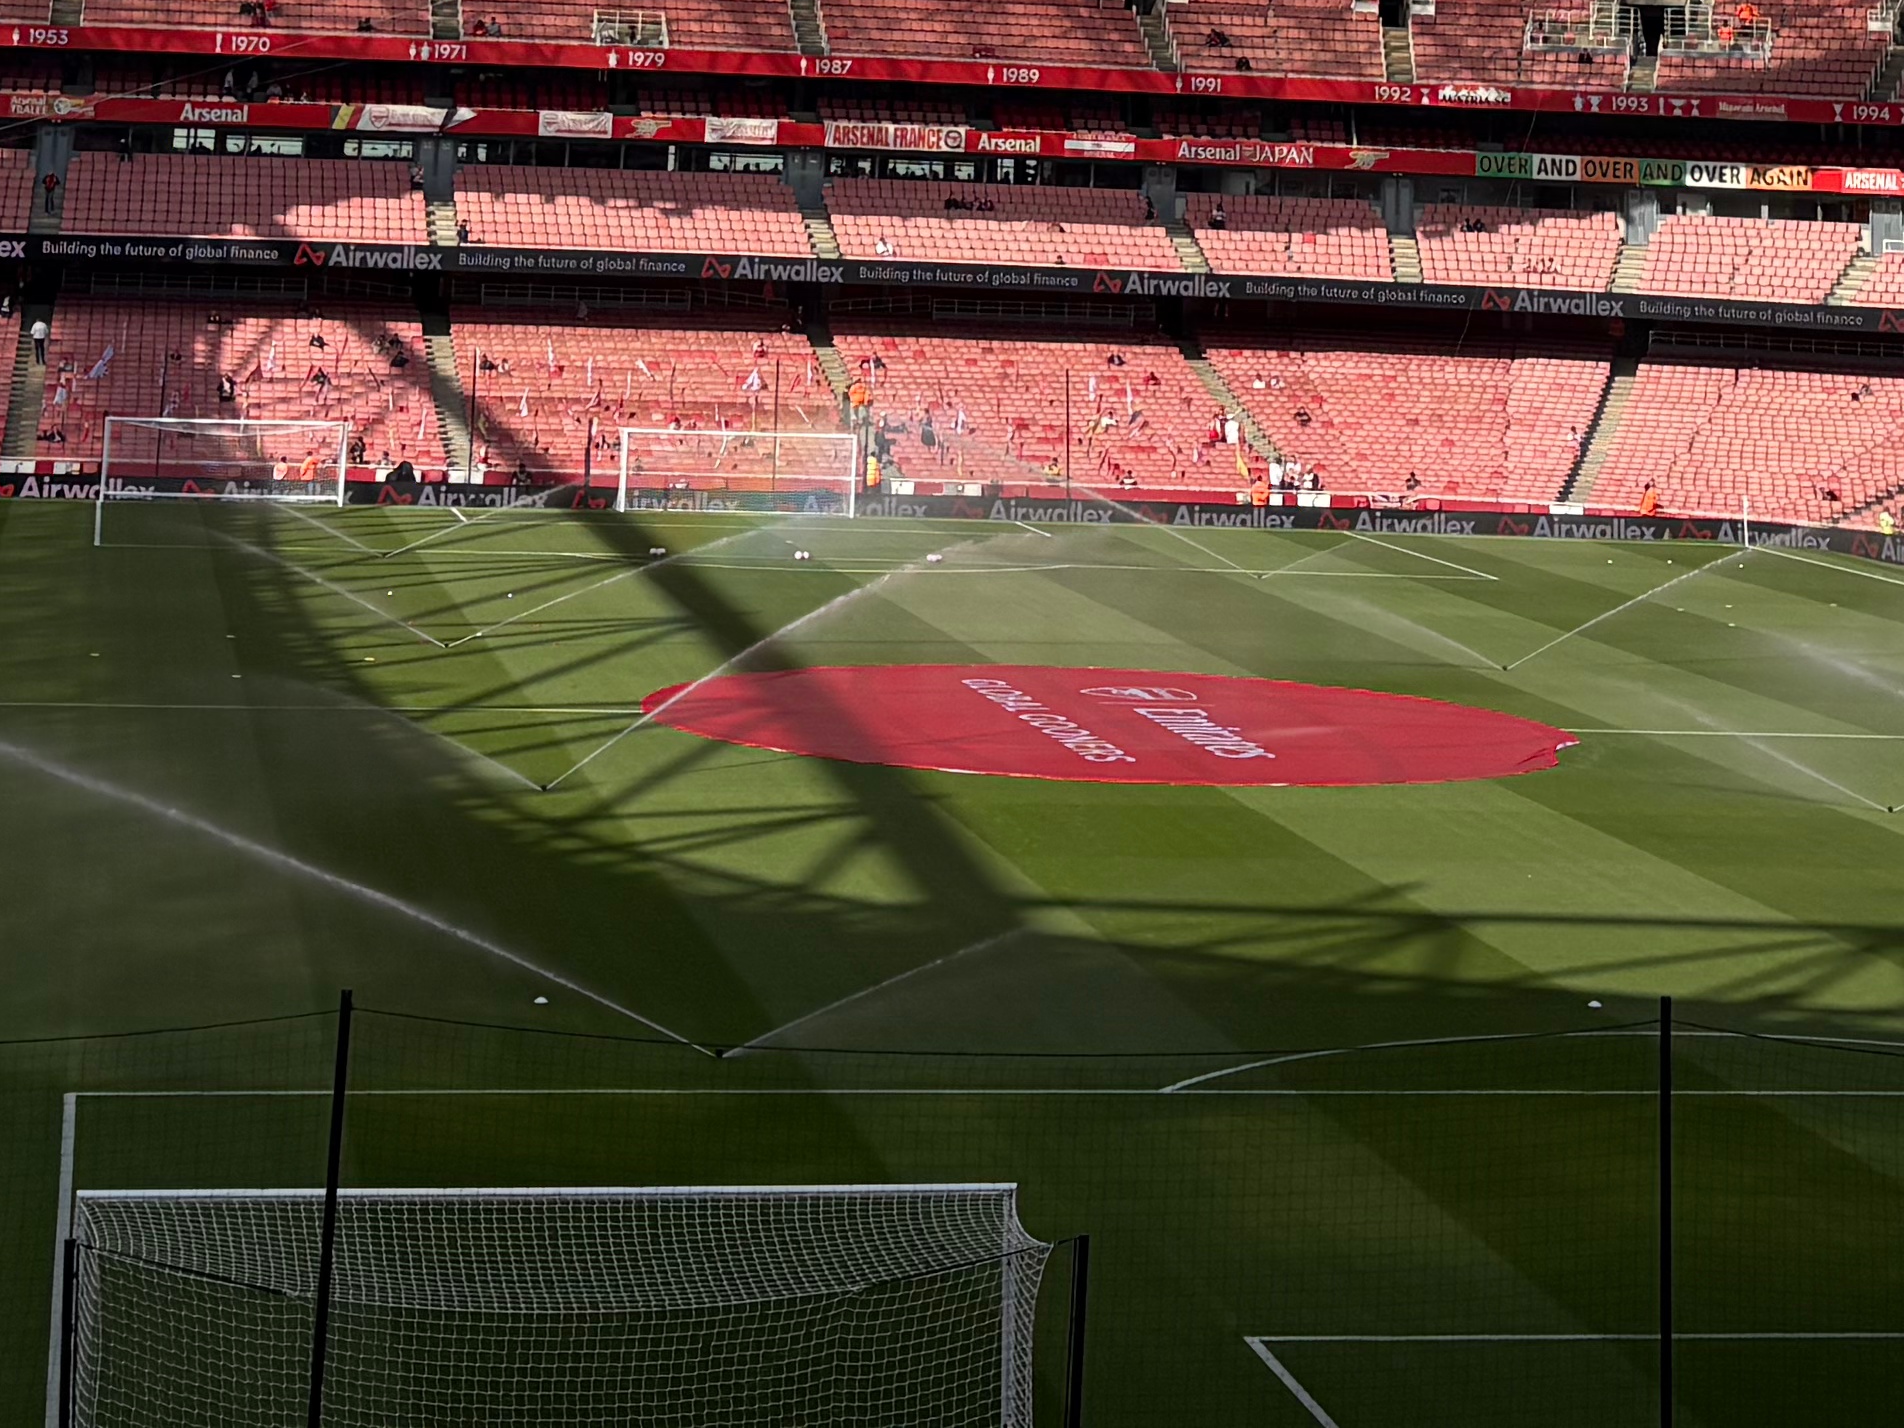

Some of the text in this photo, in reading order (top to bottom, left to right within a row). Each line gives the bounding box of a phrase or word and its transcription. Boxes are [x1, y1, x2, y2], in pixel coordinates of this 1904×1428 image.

[29, 28, 68, 44] 1953
[231, 37, 270, 51] 1970
[434, 45, 466, 60] 1971
[628, 52, 665, 66] 1979
[815, 59, 852, 74] 1987
[1002, 68, 1039, 83] 1989
[1190, 77, 1222, 92] 1991
[1374, 86, 1411, 102] 1992
[180, 103, 248, 123] Arsenal
[1611, 96, 1648, 112] 1993
[1853, 105, 1890, 120] 1994
[833, 126, 943, 150] ARSENAL FRANCE
[977, 133, 1040, 152] Arsenal
[1178, 140, 1314, 164] Arsenal JAPAN
[1480, 155, 1808, 187] OVER AND OVER AND OVER AGAIN
[1845, 173, 1898, 191] ARSENAL
[42, 240, 278, 262] Building the future of global finance
[328, 244, 442, 270] Airwallex
[458, 253, 686, 274] Building the future of global finance
[733, 257, 844, 283] Airwallex
[1124, 272, 1231, 297] Airwallex
[1514, 291, 1624, 317] Airwallex
[989, 500, 1113, 522] Airwallex
[1173, 503, 1295, 526] Airwallex
[1356, 511, 1476, 533] Airwallex
[1533, 515, 1655, 539] Airwallex
[962, 679, 1136, 763] GLOBAL GOONERS
[1134, 708, 1276, 760] Emirates
